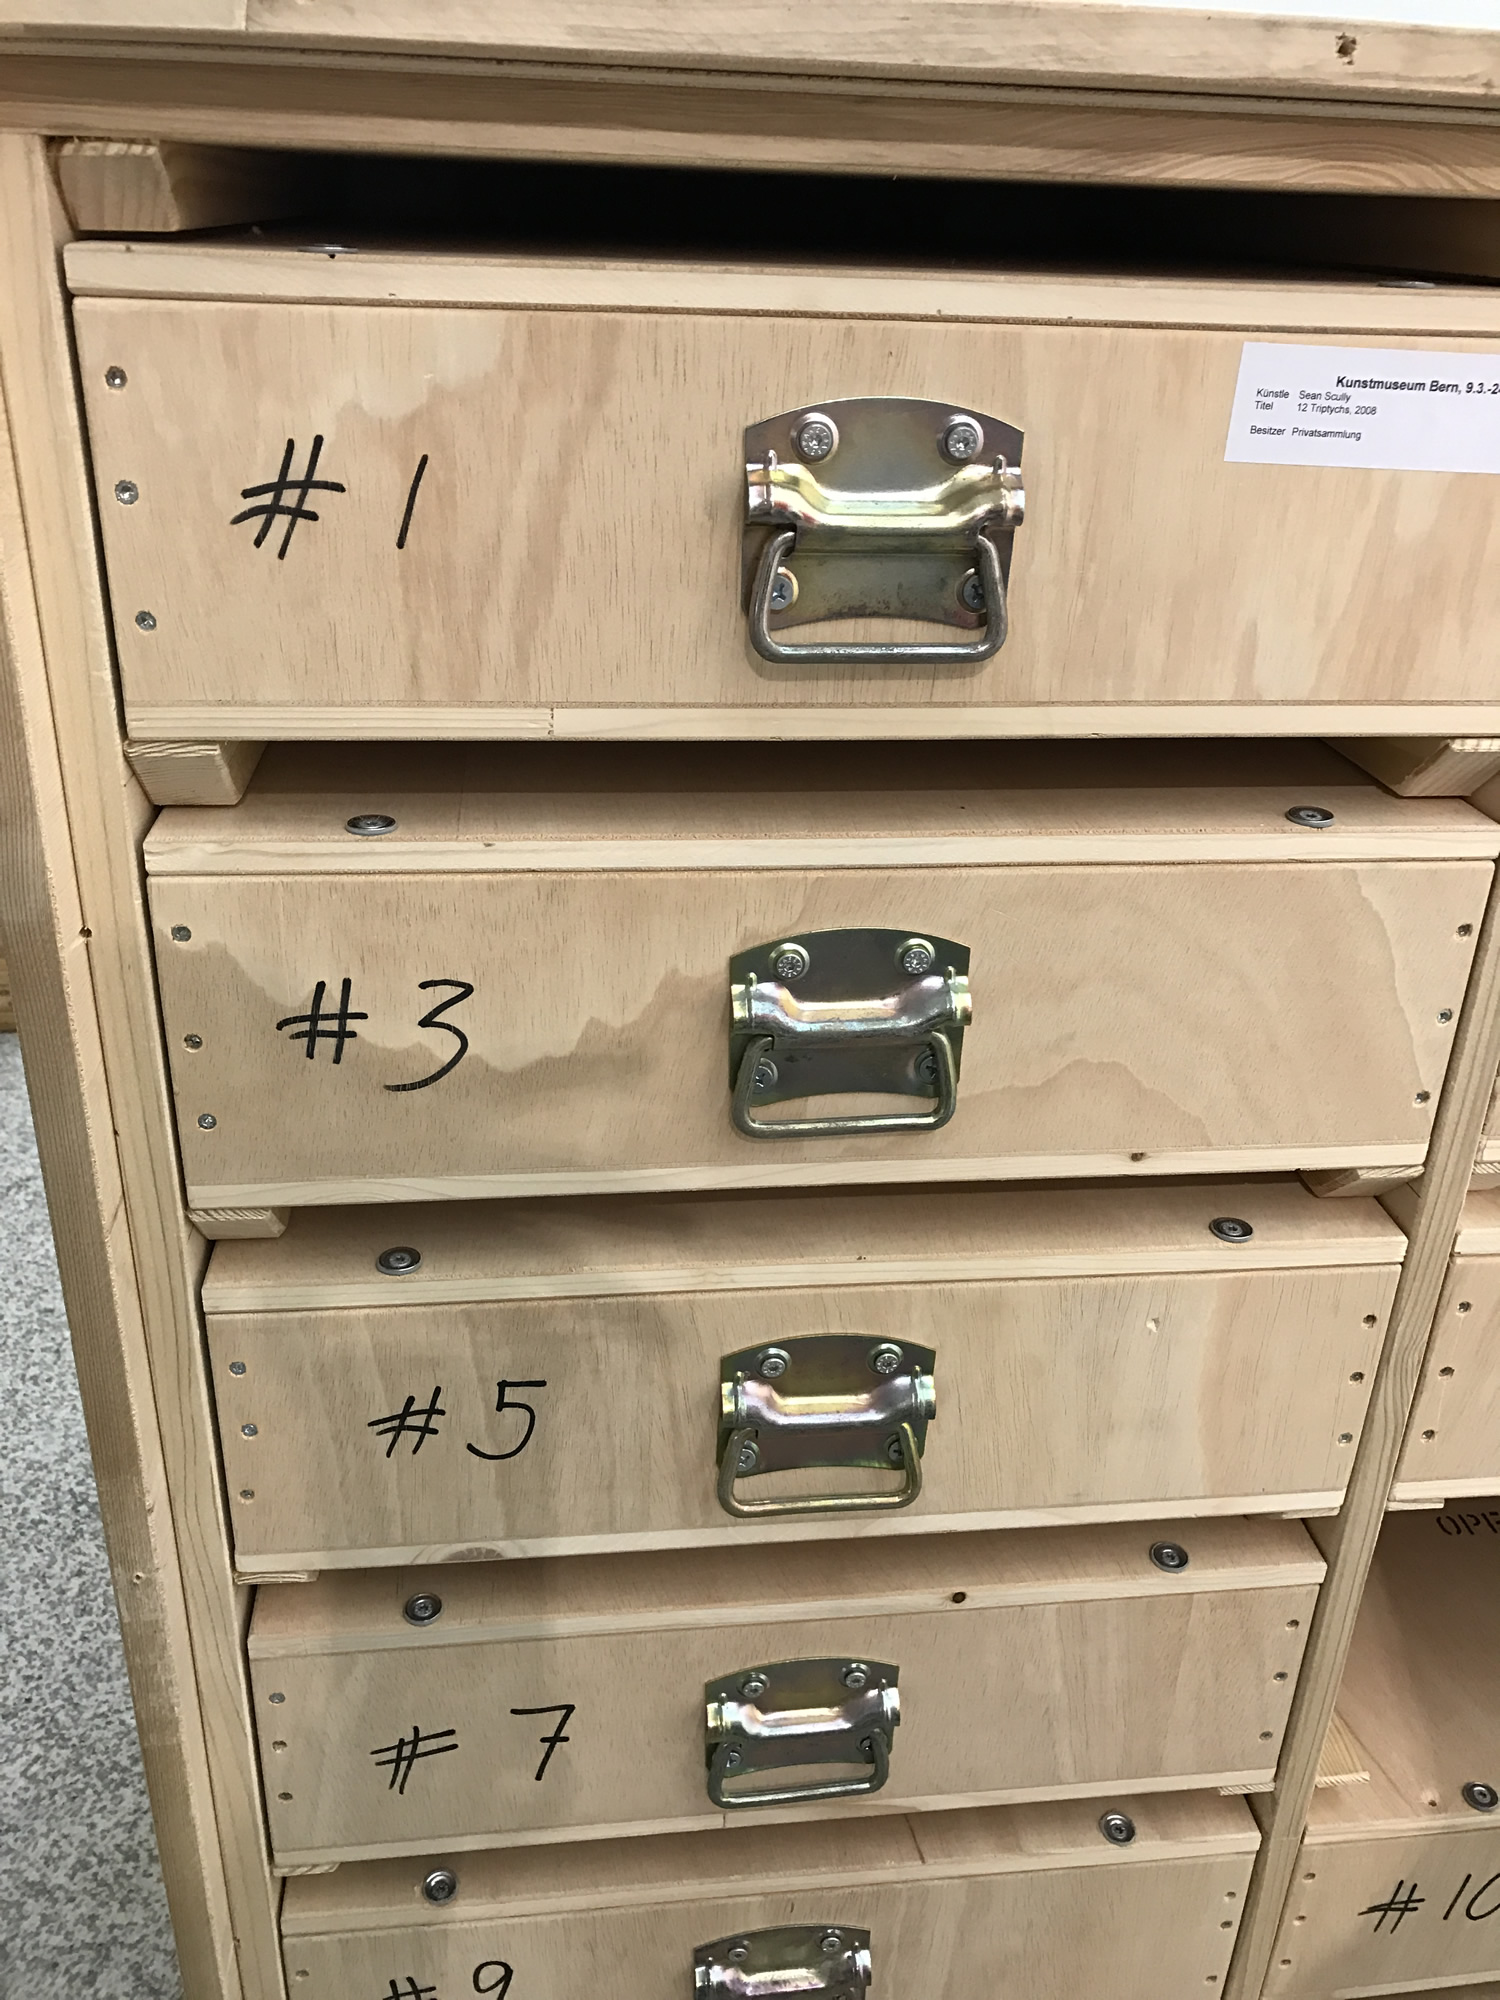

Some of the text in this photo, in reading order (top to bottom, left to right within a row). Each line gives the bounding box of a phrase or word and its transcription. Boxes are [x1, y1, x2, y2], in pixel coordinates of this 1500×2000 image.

[1336, 375, 1426, 392] Kunstmuseum
[1429, 380, 1462, 395] Bern,
[1256, 388, 1351, 403] Künstle Sean Scully
[1254, 401, 1377, 415] Titel 12 Triptychs, 2008
[1250, 425, 1362, 441] Besitzer Privatsammlung
